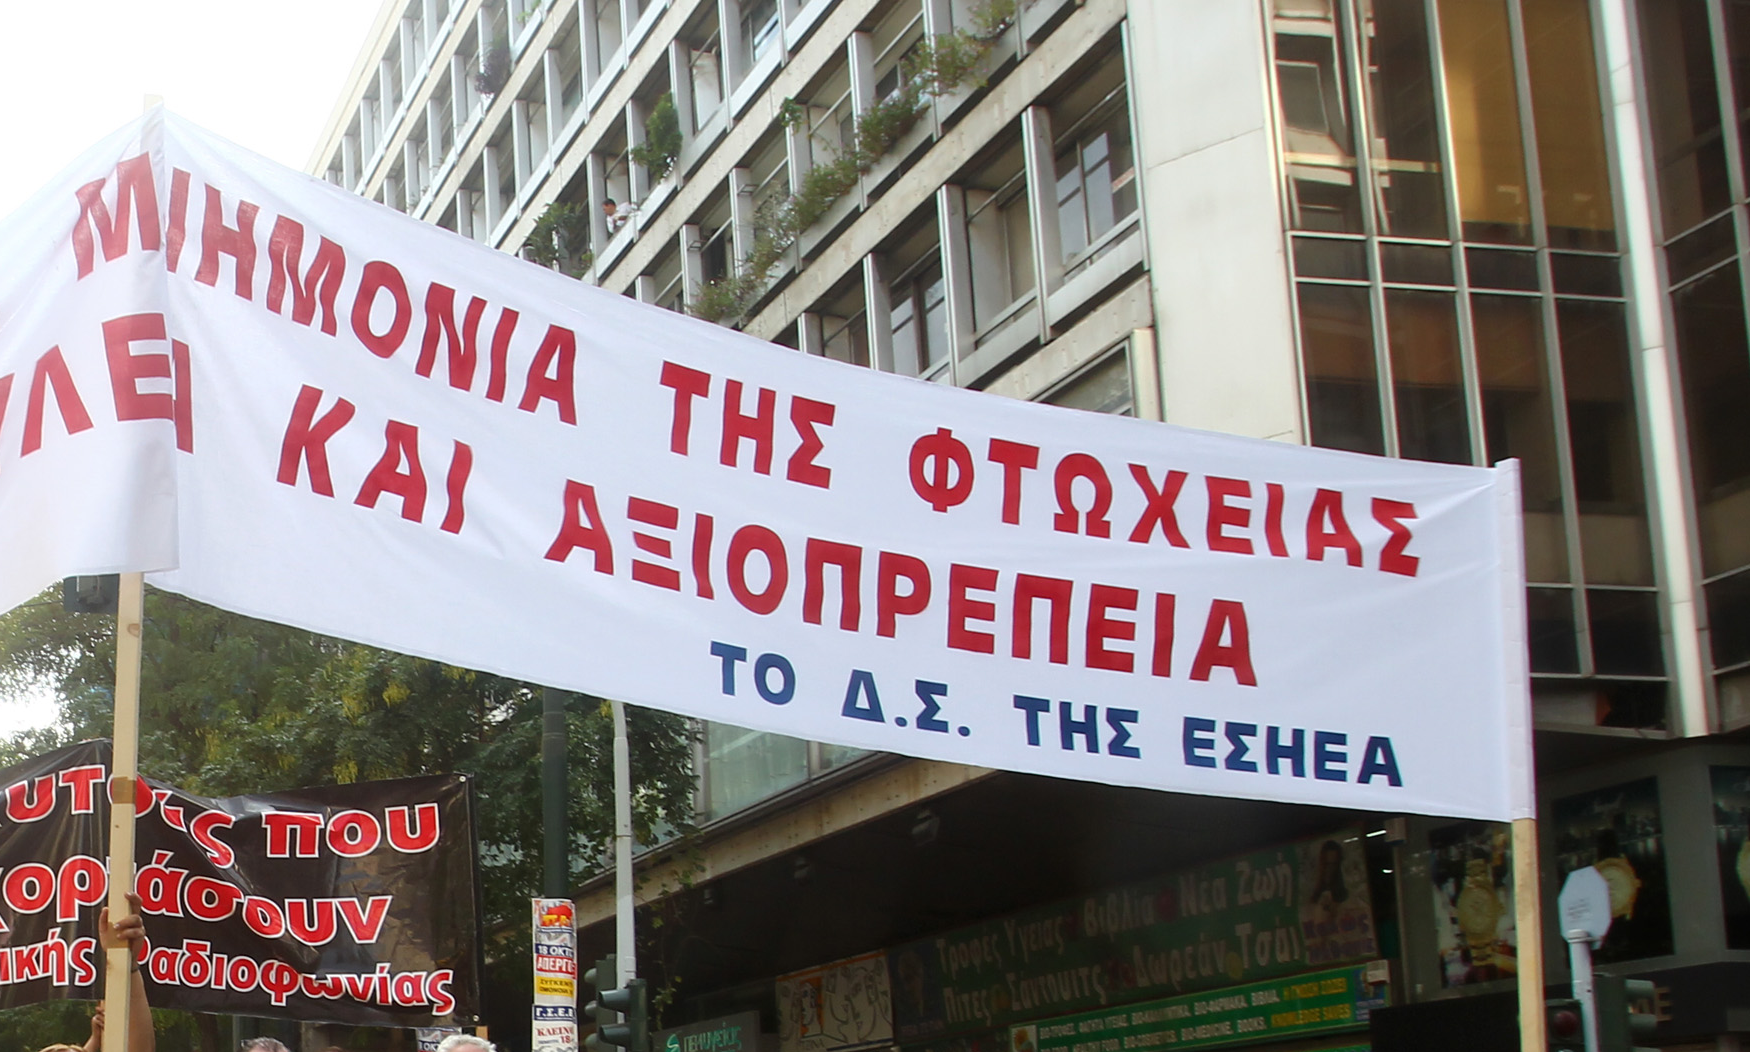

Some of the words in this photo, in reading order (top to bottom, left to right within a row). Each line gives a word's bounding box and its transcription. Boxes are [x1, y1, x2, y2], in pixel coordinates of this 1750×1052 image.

[659, 360, 836, 490] ΤΗΣ
[908, 426, 1422, 578] ΦΤΩΧΕΙΑΣ
[276, 383, 474, 535] ΚΑΙ
[544, 478, 1258, 688] ΑΞΙΟΠΡΕΠΕΙΑ
[710, 641, 797, 706] ΤΟ
[841, 669, 972, 738] Δ.Σ.
[1012, 694, 1142, 760] ΤΗΣ
[1182, 717, 1404, 788] ΕΣΗΕΑ
[260, 802, 440, 860] που
[1234, 851, 1293, 908] Ζωή
[136, 935, 456, 1016] αδιοφωνίας
